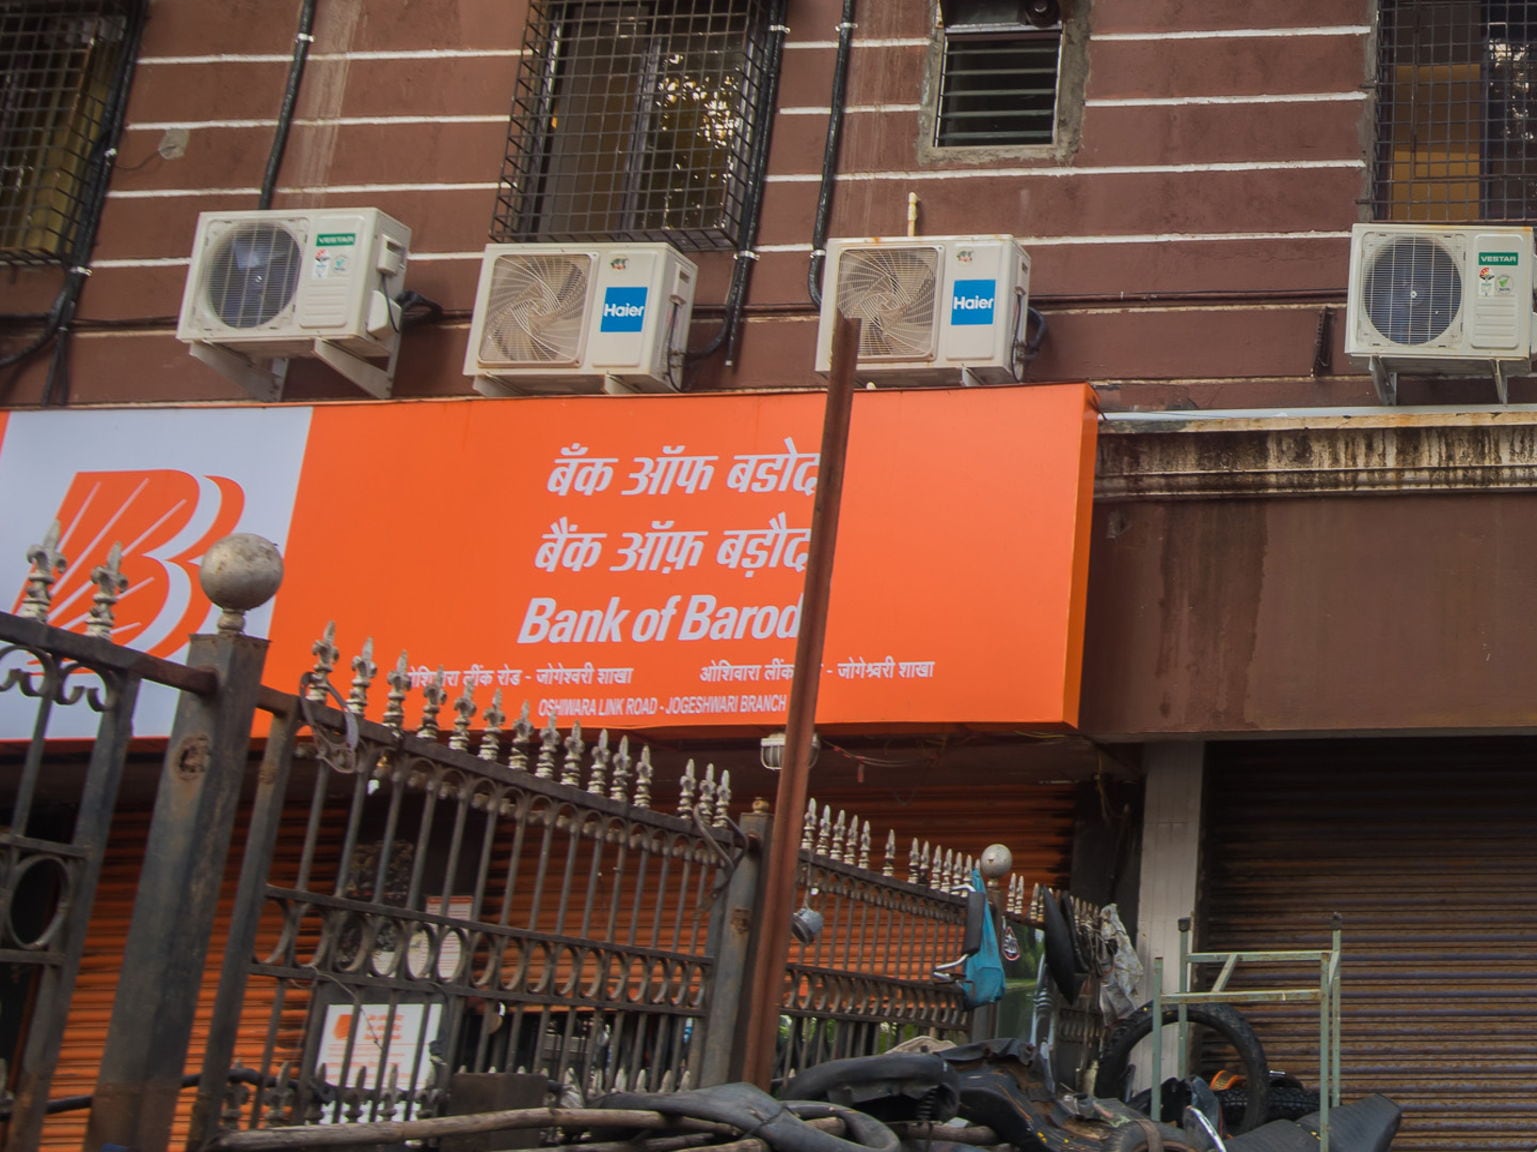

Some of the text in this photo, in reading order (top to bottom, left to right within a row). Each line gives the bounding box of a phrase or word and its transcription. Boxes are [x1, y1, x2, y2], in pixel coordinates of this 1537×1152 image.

[1480, 255, 1516, 263] VESTAR
[603, 303, 645, 318] Haier
[953, 295, 994, 310] Haier
[546, 437, 820, 496] बँक ऑफ बडोद
[534, 517, 606, 573] बैंक
[715, 512, 811, 578] बड़ौद
[517, 592, 803, 644] Bank of Barod
[497, 663, 522, 686] रोड
[597, 667, 634, 684] शाखा
[700, 659, 761, 683] ओशिवारा
[898, 660, 935, 678] शाखा
[538, 698, 597, 717] OSHIWARA
[598, 697, 625, 716] LINK
[627, 697, 658, 715] ROAD
[665, 695, 738, 715] JOGESHWARI
[740, 694, 787, 713] BRANCH
